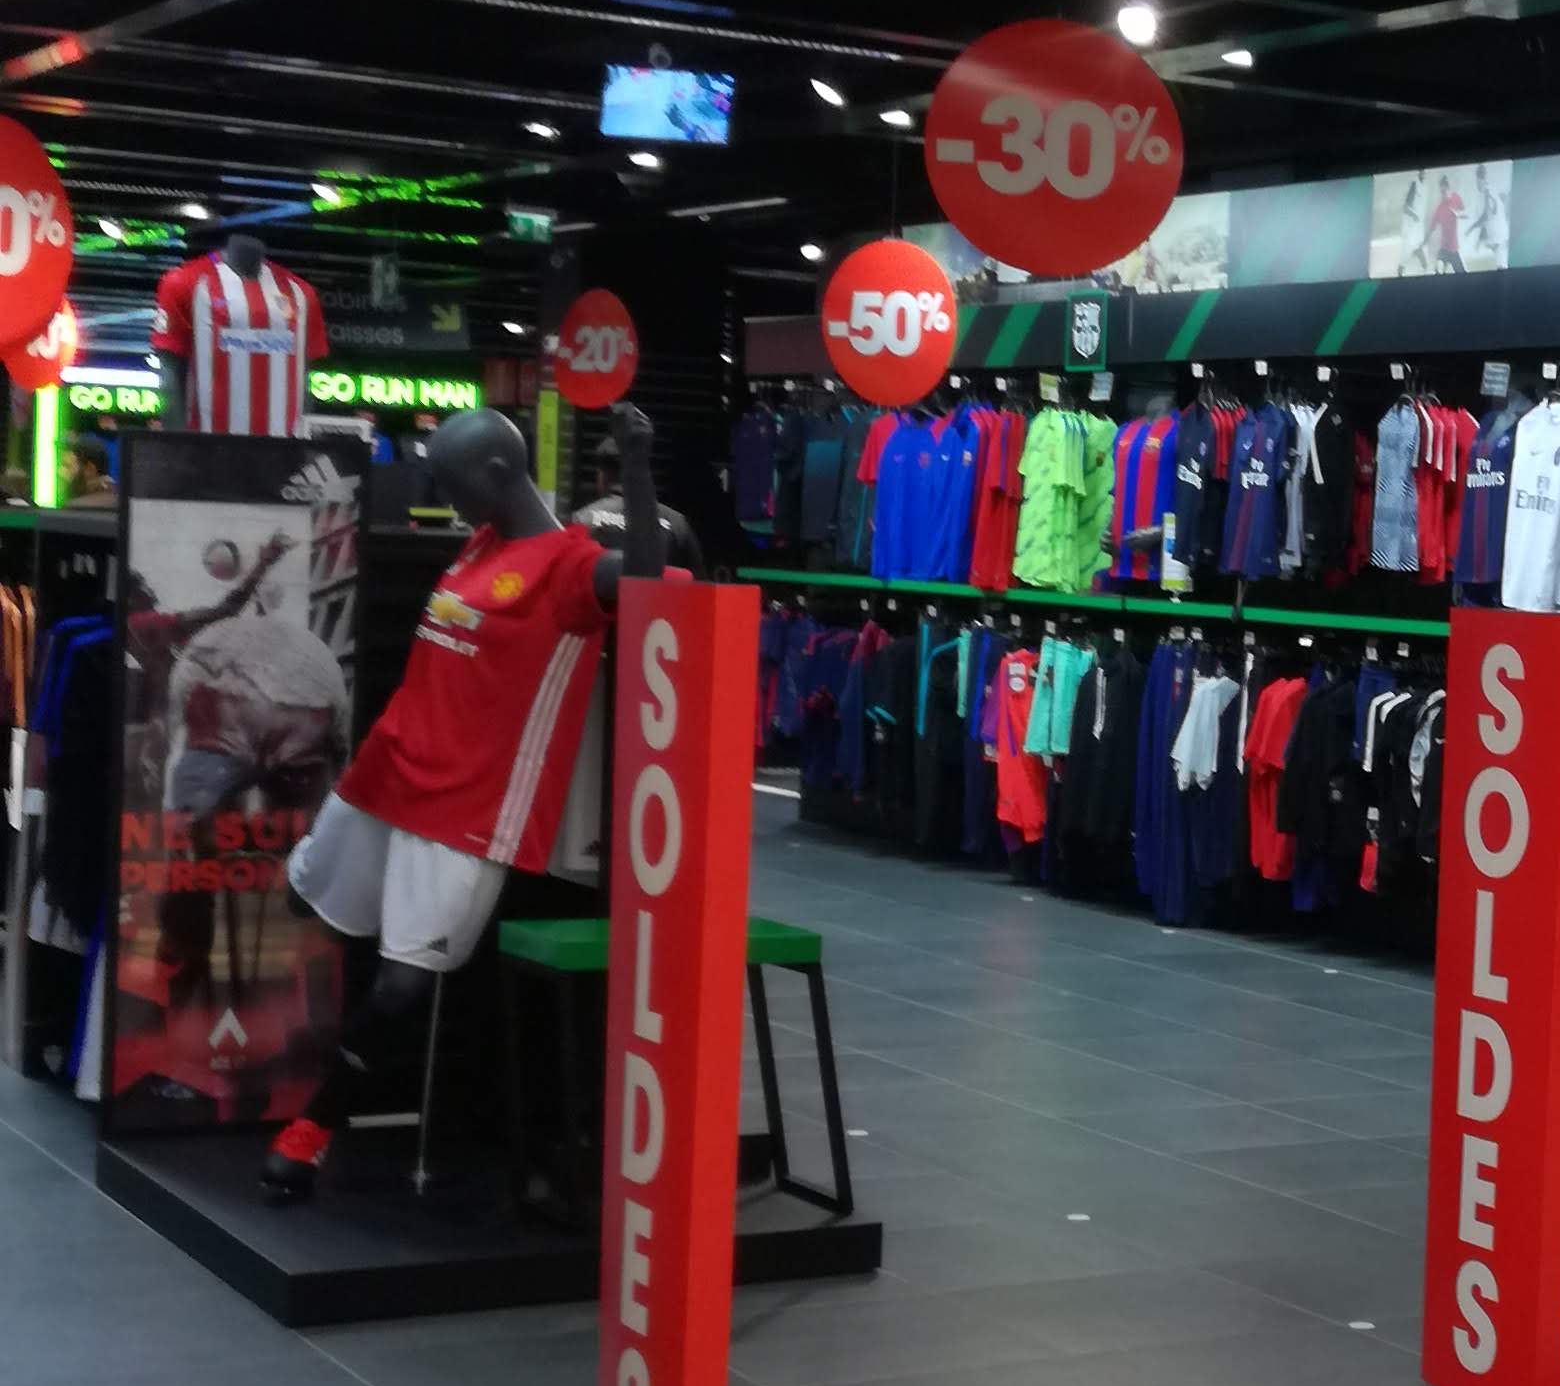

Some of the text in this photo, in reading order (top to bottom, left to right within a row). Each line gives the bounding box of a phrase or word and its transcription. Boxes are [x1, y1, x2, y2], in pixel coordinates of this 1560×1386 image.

[936, 95, 1169, 199] -30%
[0, 184, 66, 277] 0%
[327, 321, 405, 346] aisses
[827, 290, 950, 357] -50%
[557, 324, 634, 374] -20%
[69, 385, 113, 412] GO
[359, 374, 415, 406] RUN
[418, 379, 477, 410] MAN
[120, 860, 288, 893] PERSON
[1452, 643, 1530, 1374] SOLDES
